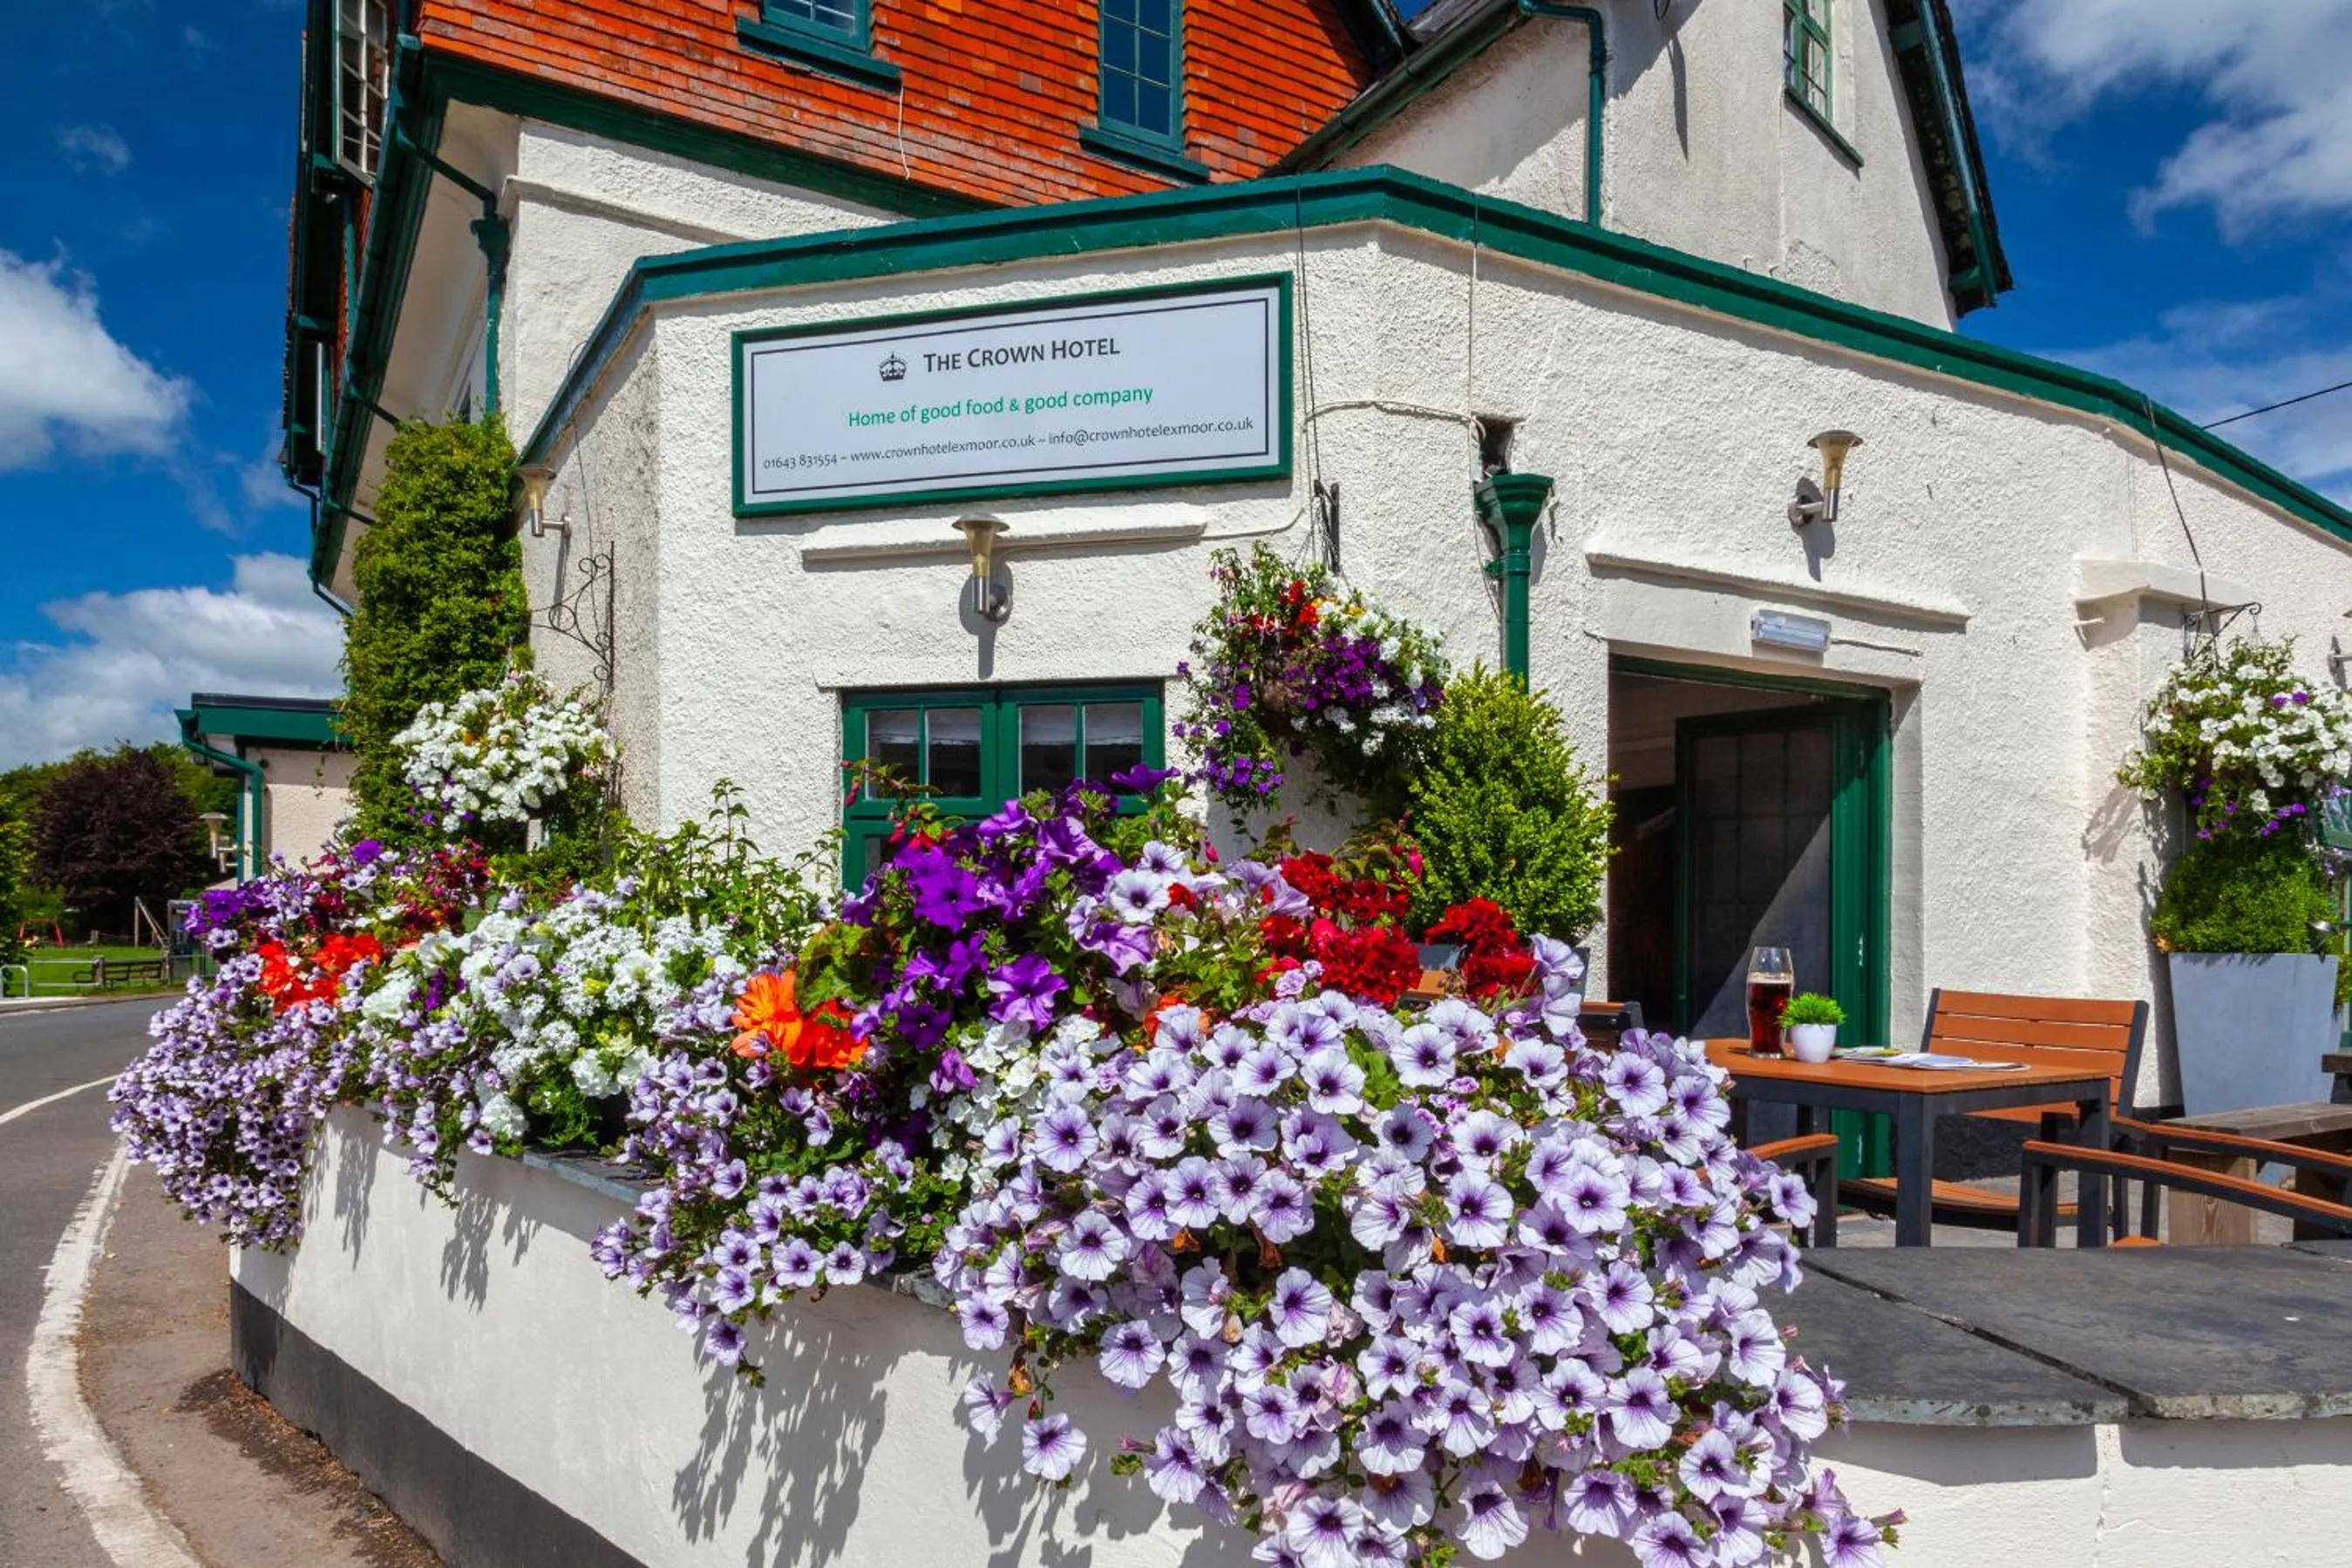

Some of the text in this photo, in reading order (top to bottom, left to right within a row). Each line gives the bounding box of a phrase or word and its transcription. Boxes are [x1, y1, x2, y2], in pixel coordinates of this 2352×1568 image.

[923, 338, 1120, 373] THE CROWN HOTEL
[848, 388, 1154, 428] Home of good food & good company
[764, 458, 796, 470] 01643
[799, 454, 838, 467] 831554
[850, 435, 1036, 462] www.crownhotelexmoor.co.uk
[1049, 417, 1254, 446] info@crownhotelexmoor.co.uk
